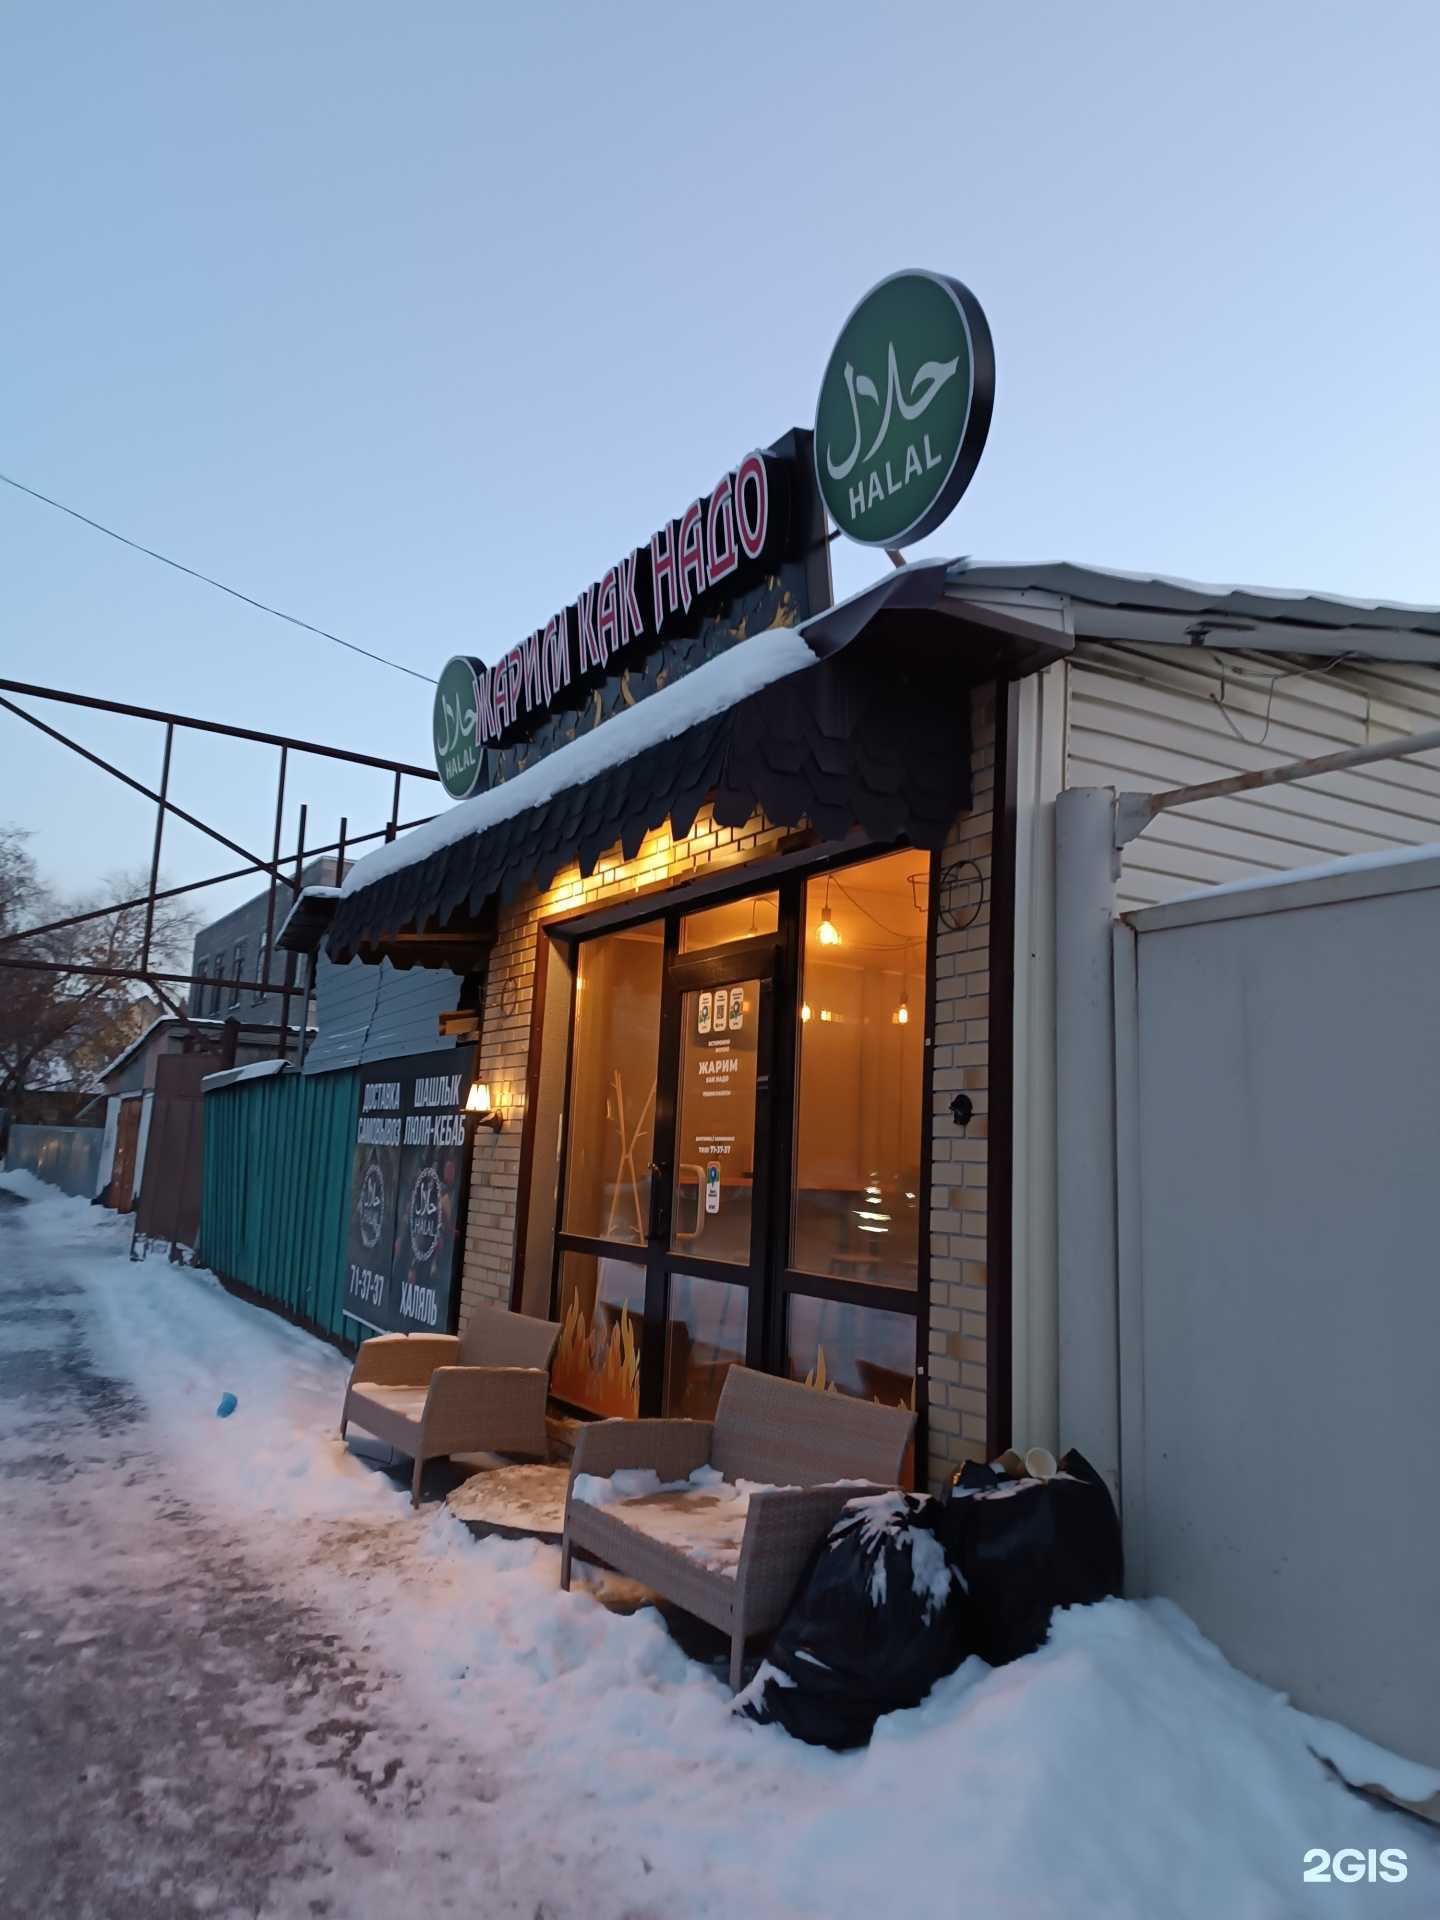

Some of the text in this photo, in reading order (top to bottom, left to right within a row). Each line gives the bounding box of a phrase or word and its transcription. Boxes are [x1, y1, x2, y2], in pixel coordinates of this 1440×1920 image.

[827, 341, 960, 480] حلال
[848, 433, 943, 520] HALAL
[472, 451, 769, 747] ЖАРИМ КАК НАДО
[445, 747, 477, 780] HALAL
[698, 1059, 738, 1075] ЖАРИМ
[362, 1082, 400, 1113] ДОСТАВКА
[414, 1074, 463, 1108] ШАШЛЫК
[403, 1114, 466, 1146] ЛЮЛЯ-КЕБАБ
[414, 1218, 436, 1237] HALAL
[350, 1264, 384, 1307] 71-37-37
[400, 1281, 438, 1327] ХАЛЯЛЬ
